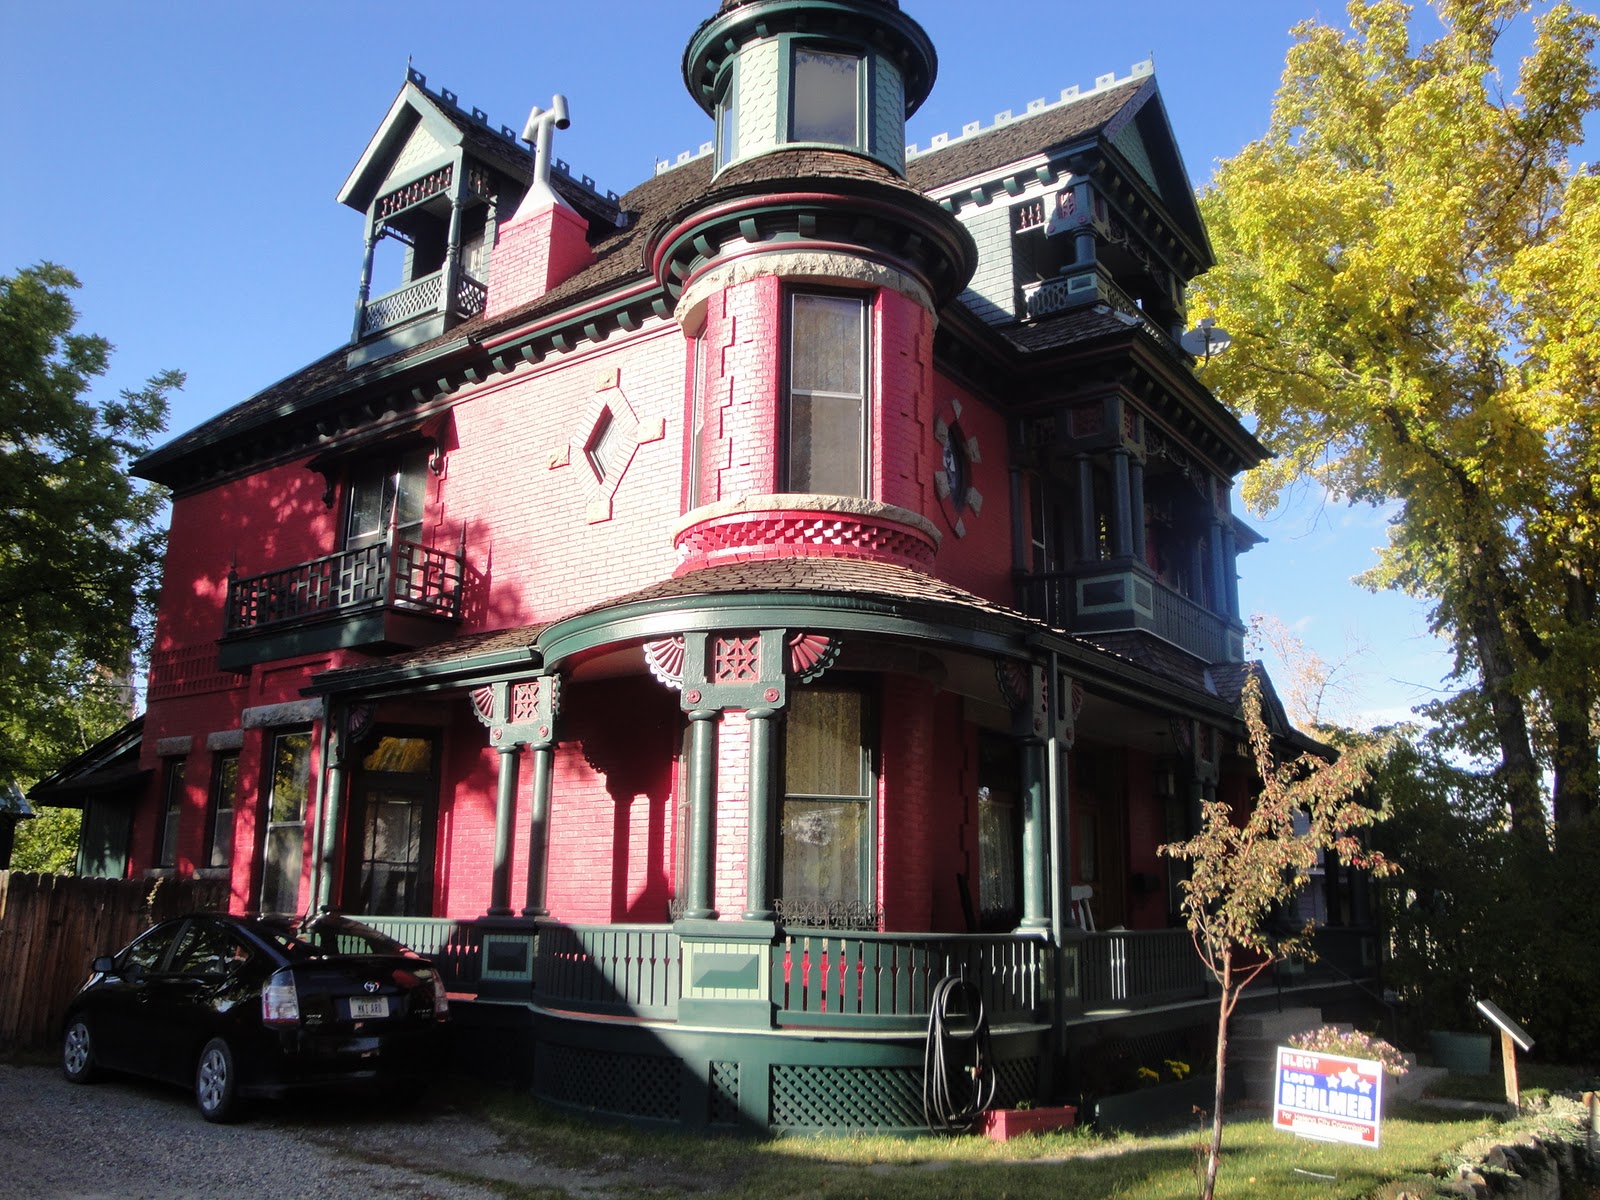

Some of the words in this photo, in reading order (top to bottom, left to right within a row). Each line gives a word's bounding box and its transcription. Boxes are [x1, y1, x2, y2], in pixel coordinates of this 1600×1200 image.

[1282, 1054, 1319, 1070] ELECT
[1282, 1082, 1372, 1119] BEHLMER
[1282, 1111, 1292, 1120] For
[1294, 1113, 1317, 1124] Helena
[1318, 1117, 1330, 1127] City
[1332, 1120, 1370, 1134] Commission
